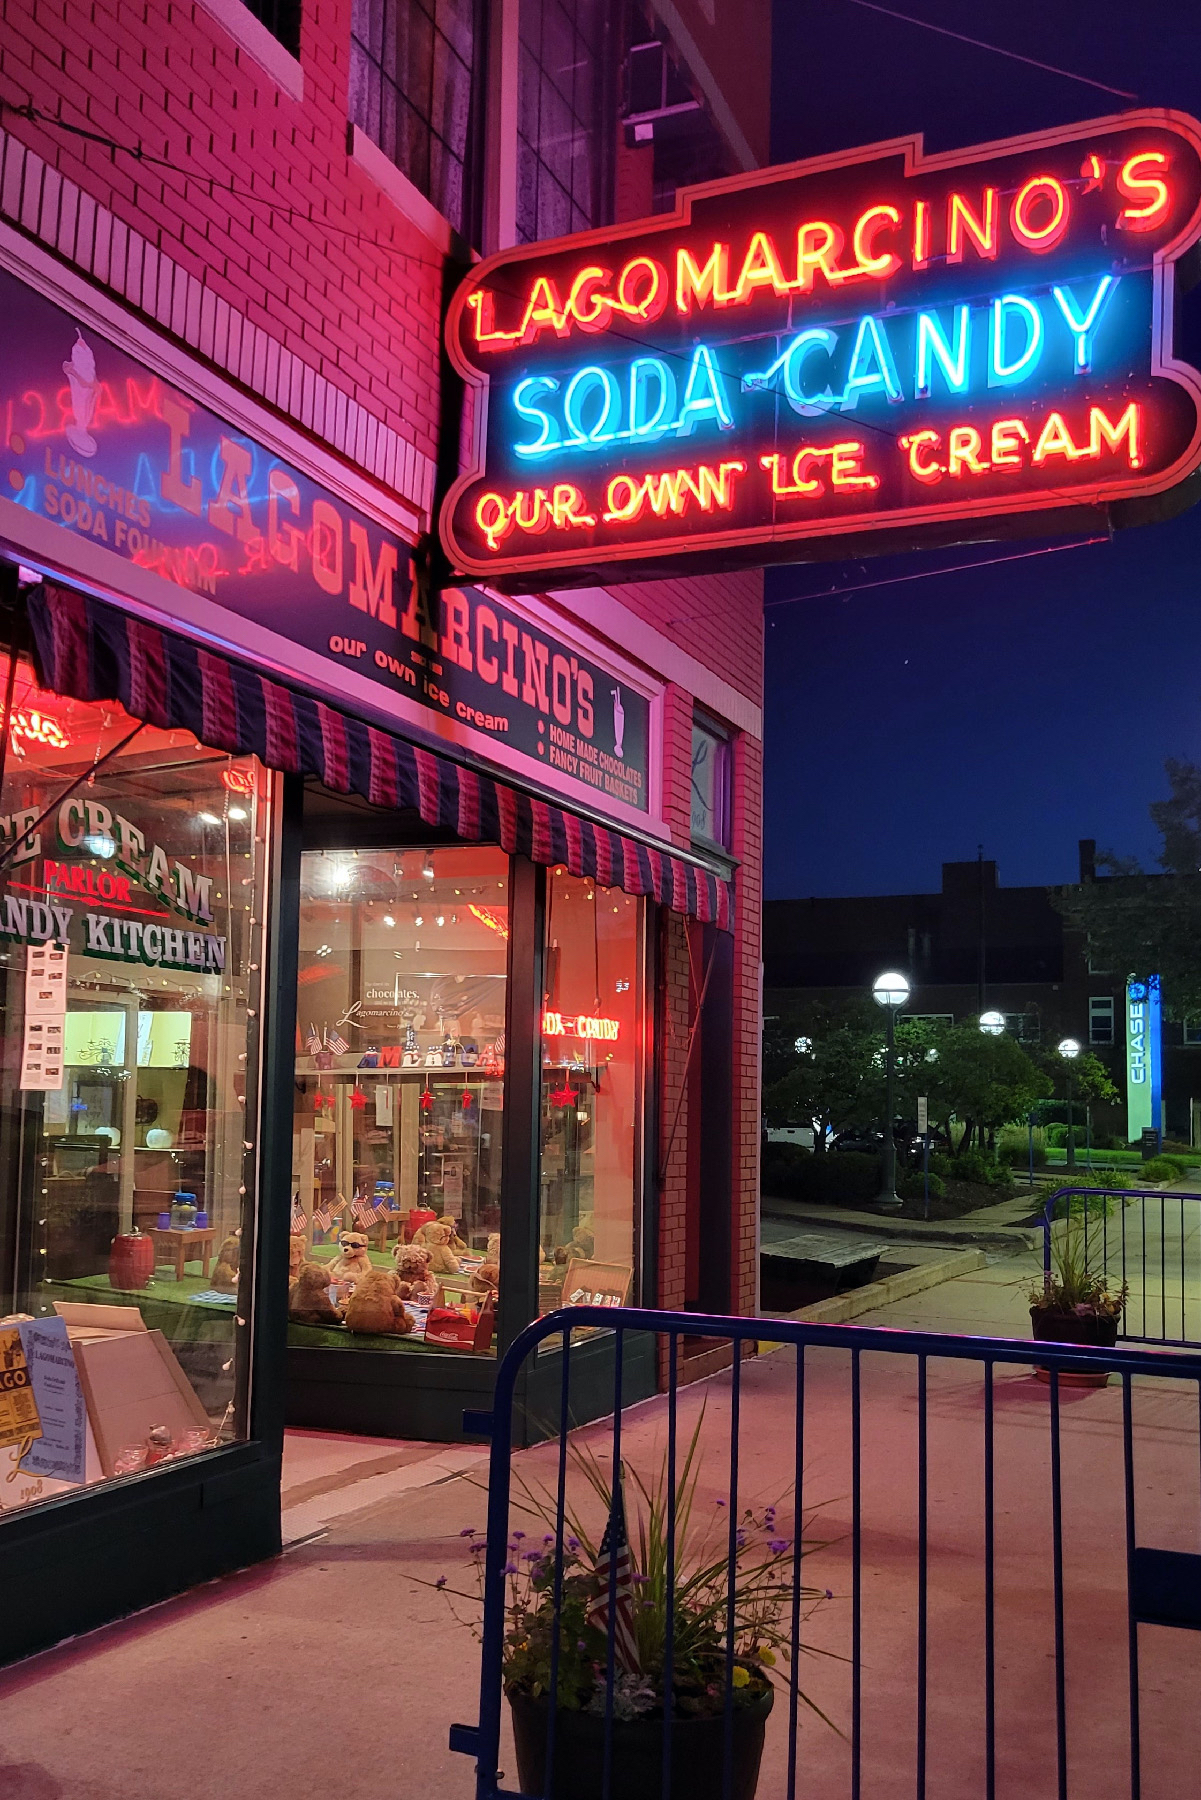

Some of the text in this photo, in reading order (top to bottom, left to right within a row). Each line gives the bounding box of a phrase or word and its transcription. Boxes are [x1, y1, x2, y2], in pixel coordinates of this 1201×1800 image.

[467, 151, 1171, 353] LAGOMARCINO'S
[44, 483, 109, 542] SODA
[45, 446, 151, 528] LUNCHES
[476, 402, 1144, 550] OUR OWN ICE CREAM
[160, 398, 594, 739] LAGOMARCINO'S
[329, 635, 367, 659] our
[374, 650, 416, 687] own
[423, 675, 450, 708] ice
[455, 701, 509, 732] cream
[549, 723, 642, 788] HOME MADE CHOCOLATES
[549, 745, 638, 805] FANCY FRUIT BASKETS
[43, 858, 133, 903] PARLOR
[0, 894, 226, 969] NDY KITCHEN
[1130, 1002, 1146, 1084] CHASE
